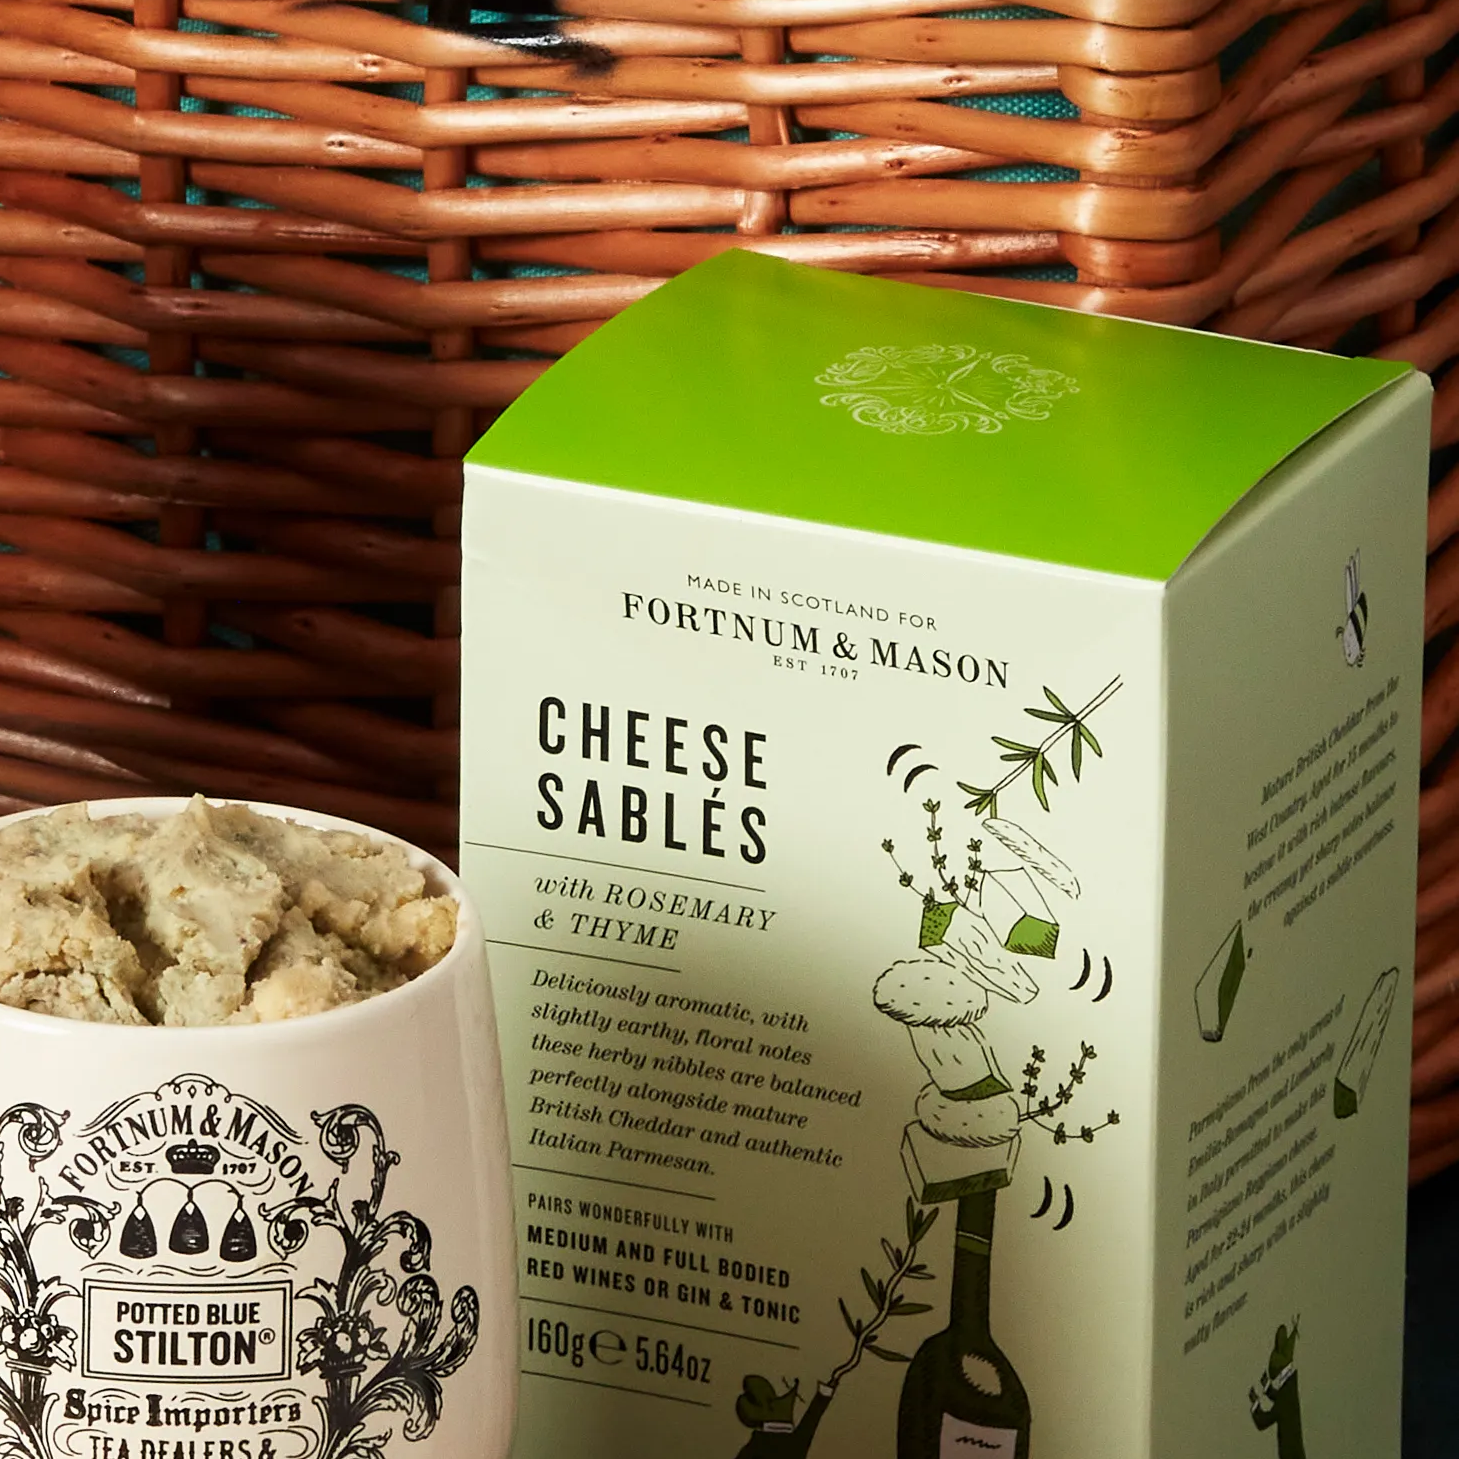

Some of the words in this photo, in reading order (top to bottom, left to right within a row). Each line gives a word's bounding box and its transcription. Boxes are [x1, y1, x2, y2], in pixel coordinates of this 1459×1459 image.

[686, 572, 743, 597] MADE
[750, 586, 771, 603] IN
[779, 589, 890, 623] SCOTLAND
[898, 612, 937, 632] FOR
[621, 591, 820, 654] FORTNUM
[831, 631, 859, 660] &
[870, 637, 1012, 689] MASON
[772, 654, 808, 671] EST
[820, 664, 860, 681] 1707
[538, 696, 768, 791] CHEESE
[1261, 768, 1294, 805] Mature
[1295, 737, 1327, 774] British
[537, 773, 768, 866] SABLÉS
[1246, 824, 1269, 851] West
[533, 874, 596, 903] with
[603, 884, 779, 932] ROSEMARY
[533, 909, 555, 931] &
[570, 911, 681, 951] THYME
[531, 969, 651, 1010] Deliciously
[654, 989, 756, 1025] aromatic,
[761, 1007, 810, 1033] with
[531, 1001, 613, 1035] slightly
[616, 1015, 690, 1048] earthy,
[695, 1026, 754, 1055] floral
[758, 1041, 813, 1065] notes
[529, 1065, 623, 1101] perfectly
[627, 1079, 728, 1115] alongside
[732, 1101, 809, 1130] mature
[531, 1033, 583, 1056] these
[588, 1040, 648, 1072] herby
[651, 1051, 727, 1083] nibbles
[730, 1066, 765, 1086] are
[768, 1073, 863, 1109] balanced
[529, 1096, 604, 1124] British
[608, 1107, 696, 1139] Cheddar
[699, 1127, 742, 1148] and
[744, 1134, 844, 1169] authentic
[1188, 1082, 1246, 1142] Parmigiano
[58, 1106, 195, 1193] FORTNUM
[199, 1104, 224, 1135] &
[229, 1106, 314, 1197] MASON
[529, 1127, 602, 1156] Italian
[607, 1141, 716, 1176] Parmesan.
[528, 1193, 573, 1216] PAIRS
[578, 1200, 690, 1235] WONDERFULLY
[695, 1221, 735, 1244] WITH
[527, 1225, 608, 1256] MEDIUM
[615, 1239, 656, 1263] AND
[663, 1249, 712, 1274] FULL
[717, 1258, 791, 1289] BODIED
[116, 1301, 199, 1326] POTTED
[205, 1301, 261, 1325] BLUE
[526, 1258, 565, 1280] RED
[572, 1265, 636, 1294] WINES
[644, 1278, 671, 1300] OR
[677, 1284, 712, 1308] GIN
[740, 1297, 802, 1326] TONIC
[635, 1334, 713, 1386] 5.64oz
[63, 1389, 141, 1427] Spice
[145, 1394, 302, 1433] Importers
